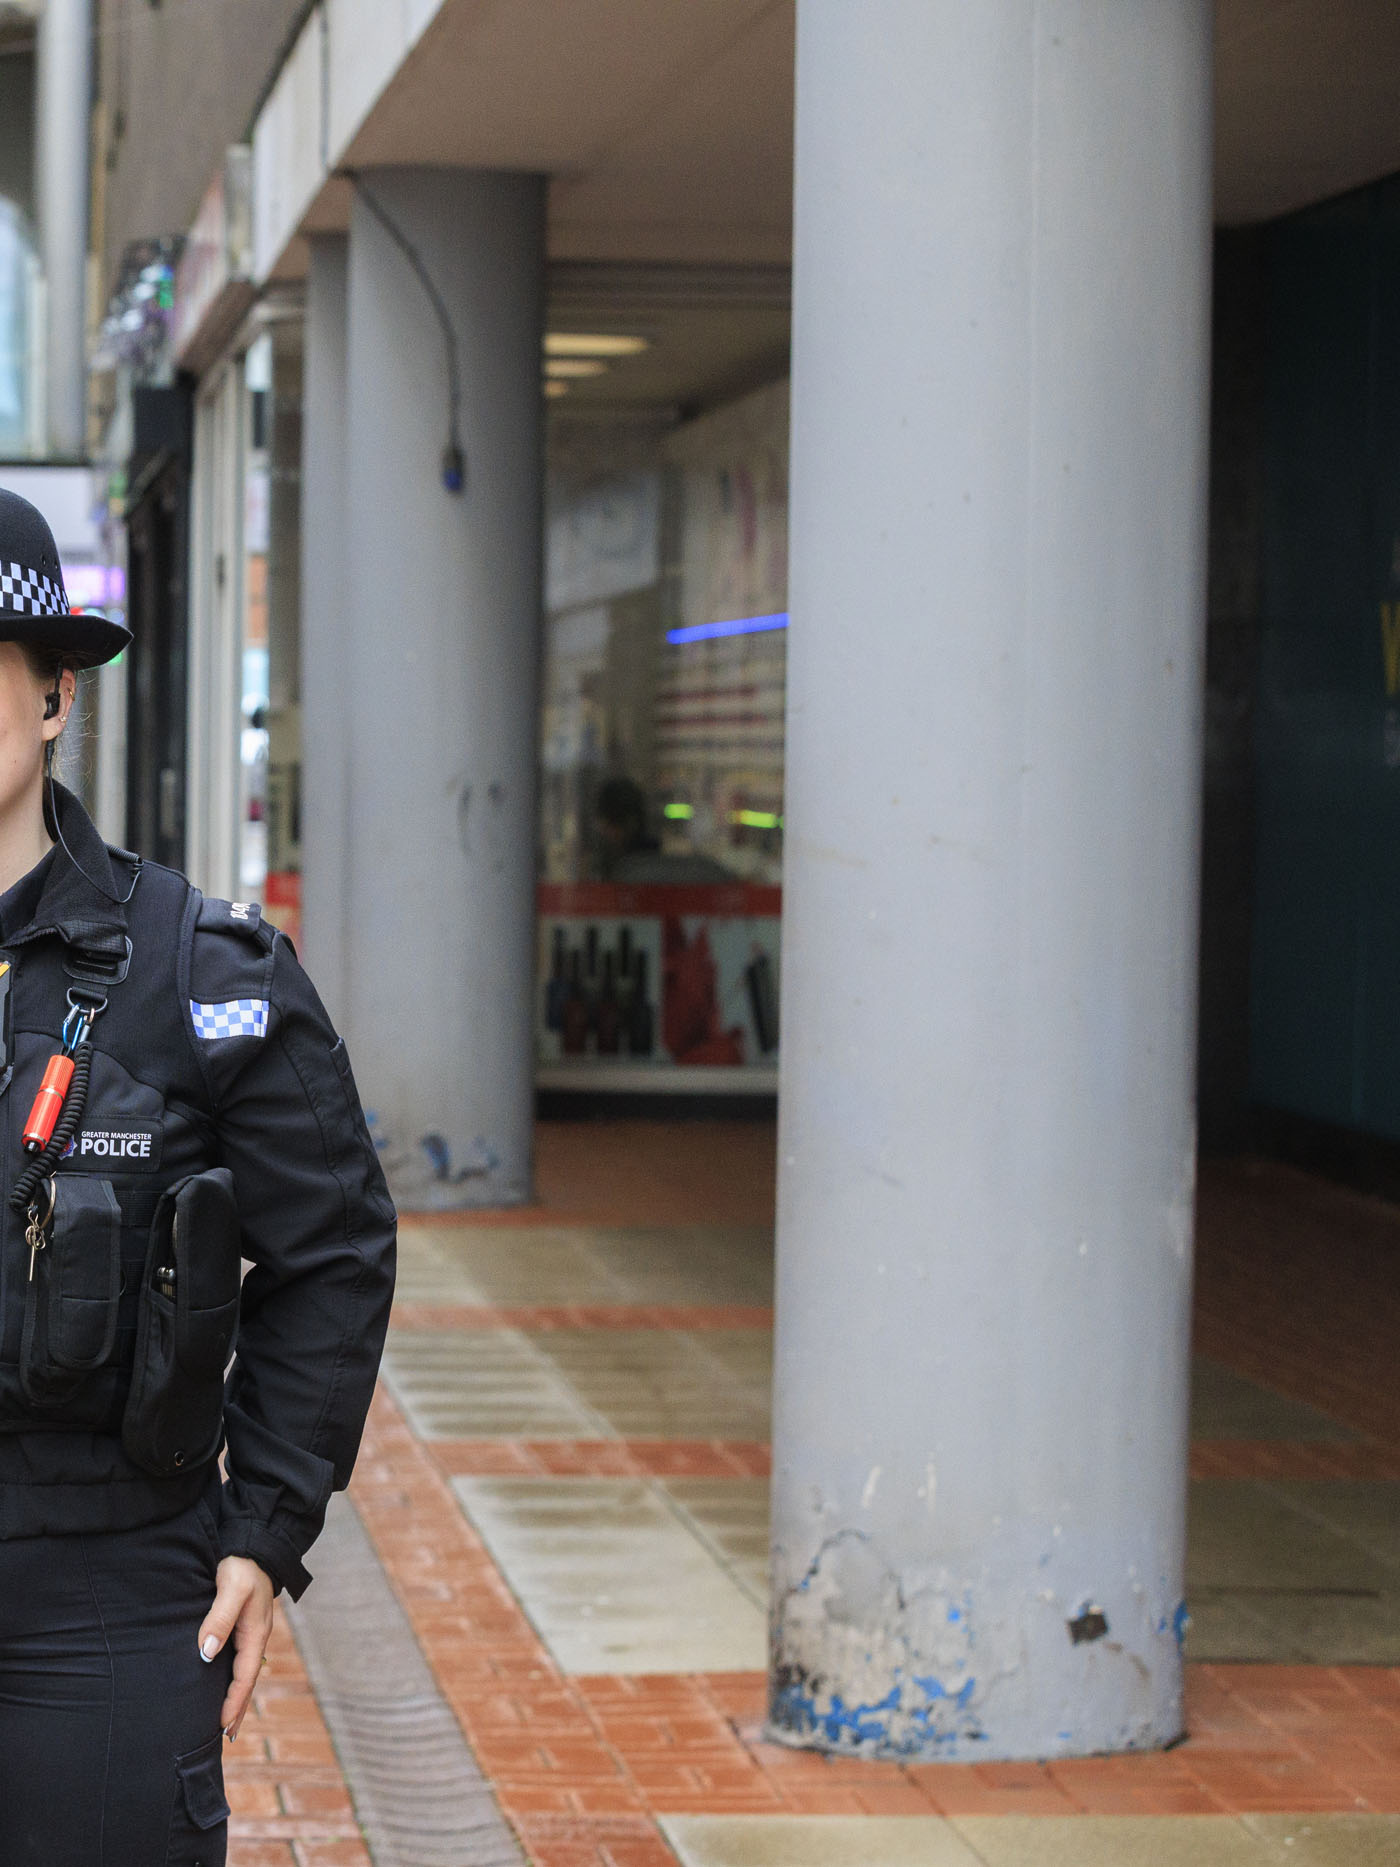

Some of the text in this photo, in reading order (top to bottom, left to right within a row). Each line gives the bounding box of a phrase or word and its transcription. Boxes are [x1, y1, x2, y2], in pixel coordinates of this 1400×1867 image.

[81, 1130, 152, 1140] GREATER MANCHESTER
[81, 1138, 151, 1157] POLICE
